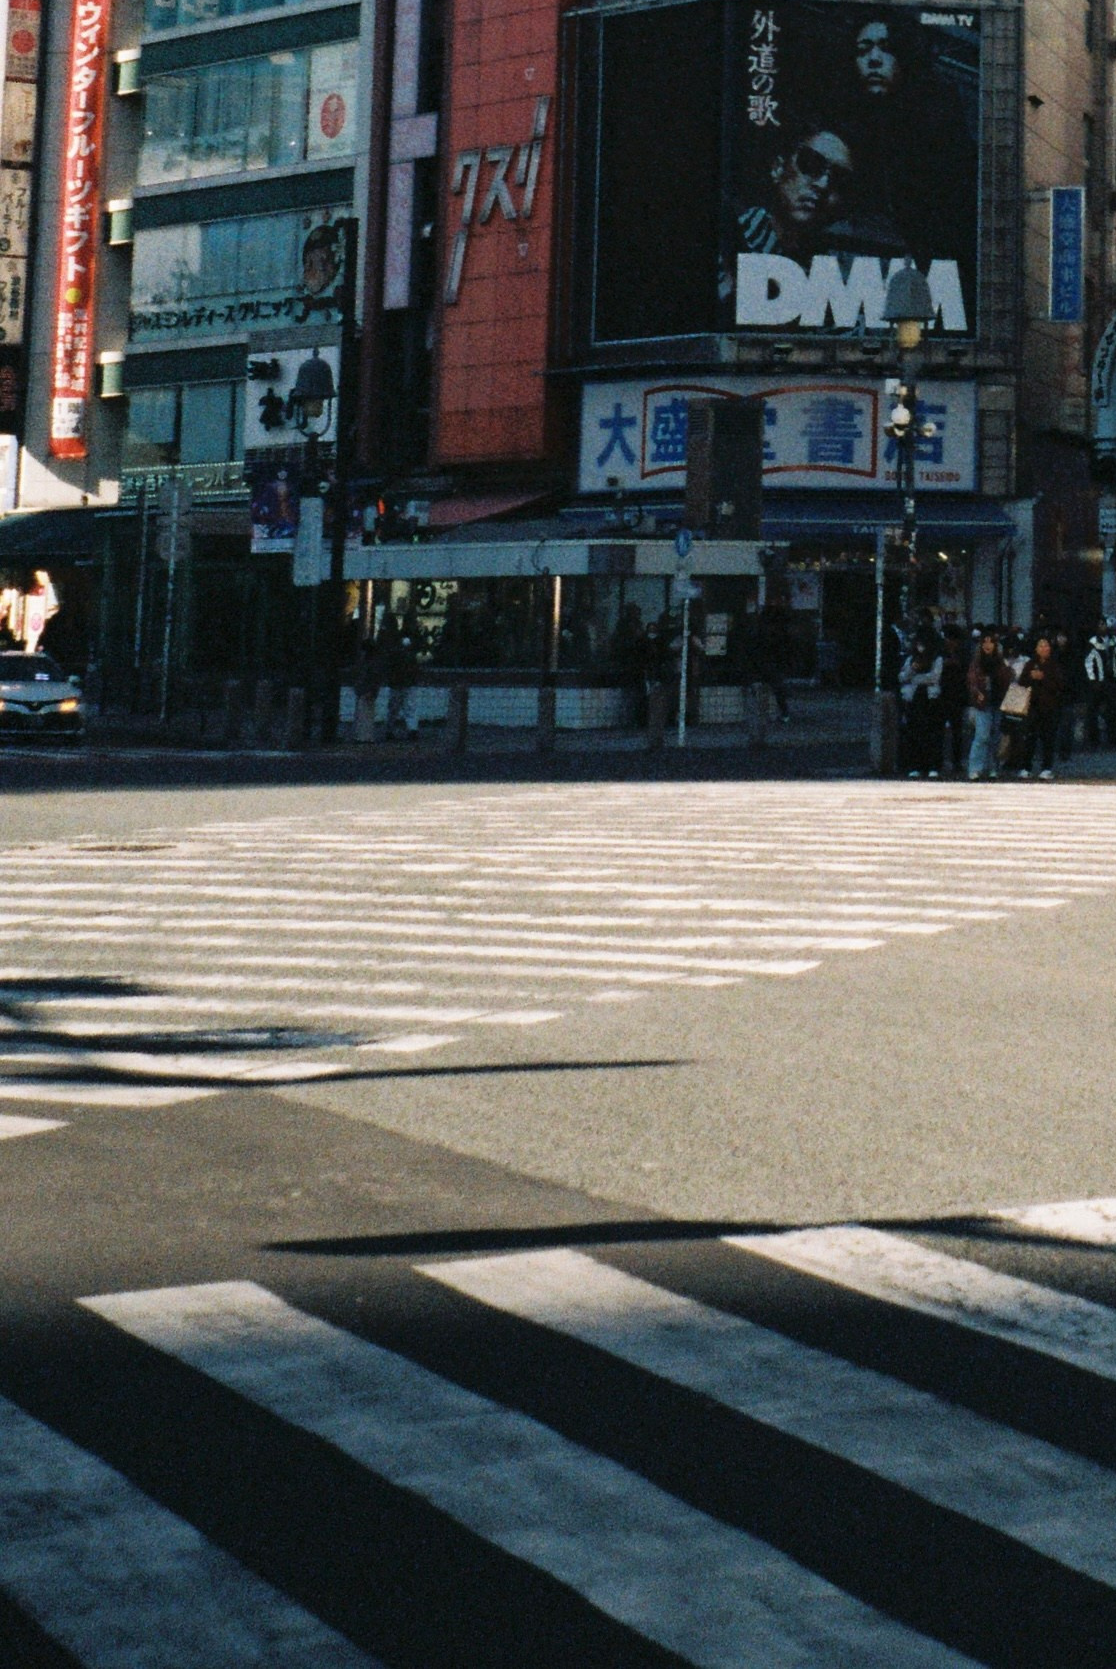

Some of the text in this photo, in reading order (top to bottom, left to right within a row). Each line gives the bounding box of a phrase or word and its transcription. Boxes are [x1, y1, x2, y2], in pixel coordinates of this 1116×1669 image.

[957, 14, 975, 27] TV
[747, 9, 781, 128] 外道の歌
[596, 397, 949, 466] 大盛書店
